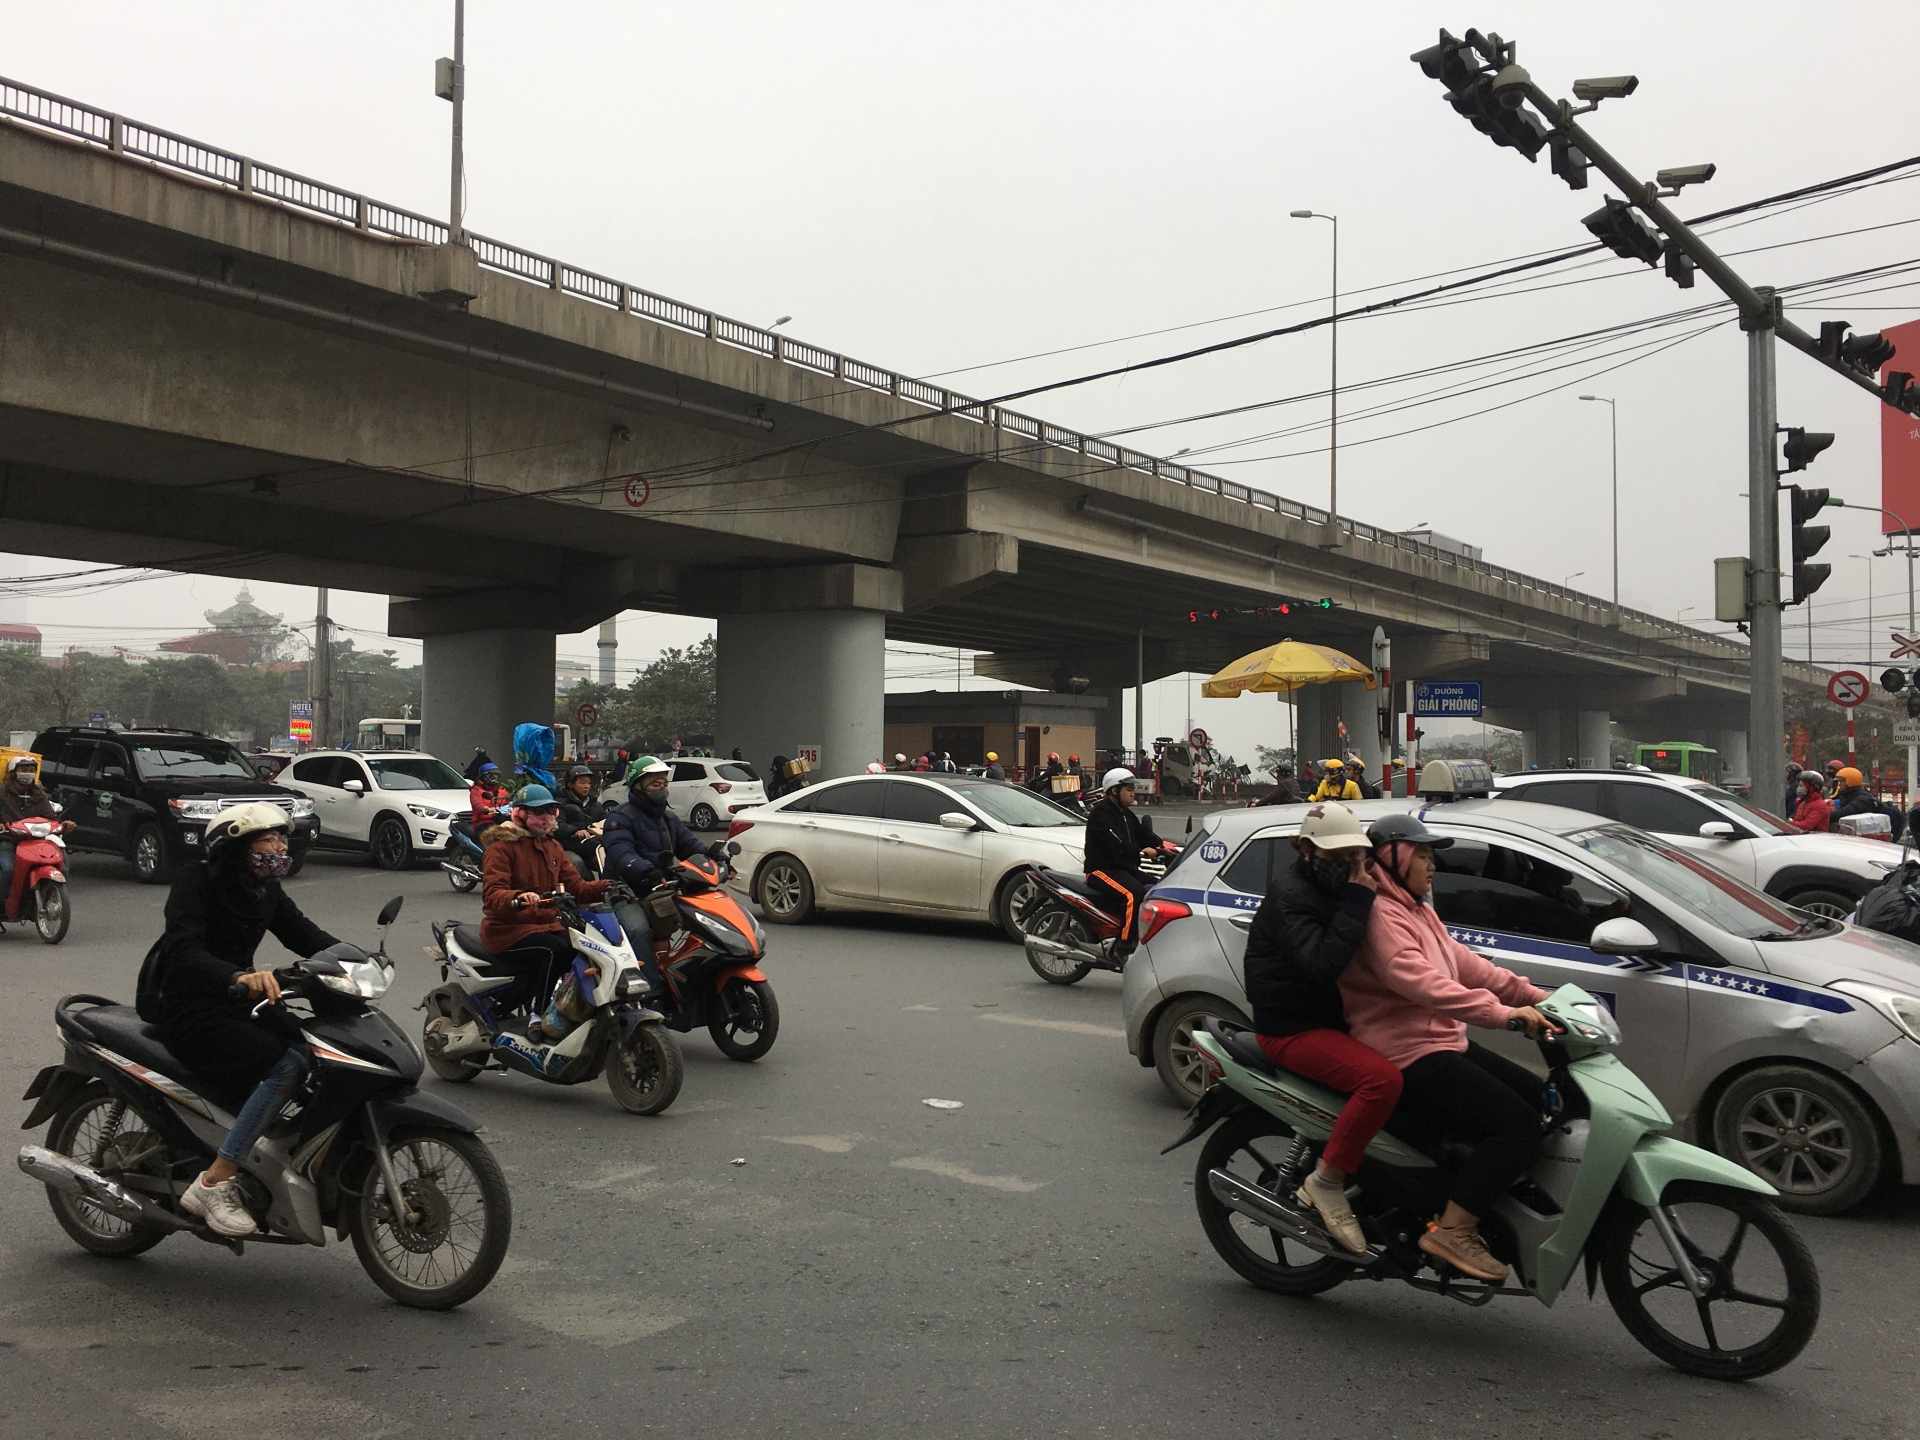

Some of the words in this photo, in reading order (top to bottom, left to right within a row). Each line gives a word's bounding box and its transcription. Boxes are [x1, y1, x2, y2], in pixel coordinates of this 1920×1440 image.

[126, 653, 150, 661] TOTA
[1228, 680, 1247, 690] CSGT
[1434, 686, 1464, 695] ĐƯỜNG
[292, 703, 312, 711] HOTEL
[1418, 695, 1439, 711] GIẢI
[1442, 696, 1478, 711] PHÓNG
[1203, 845, 1225, 859] 1884
